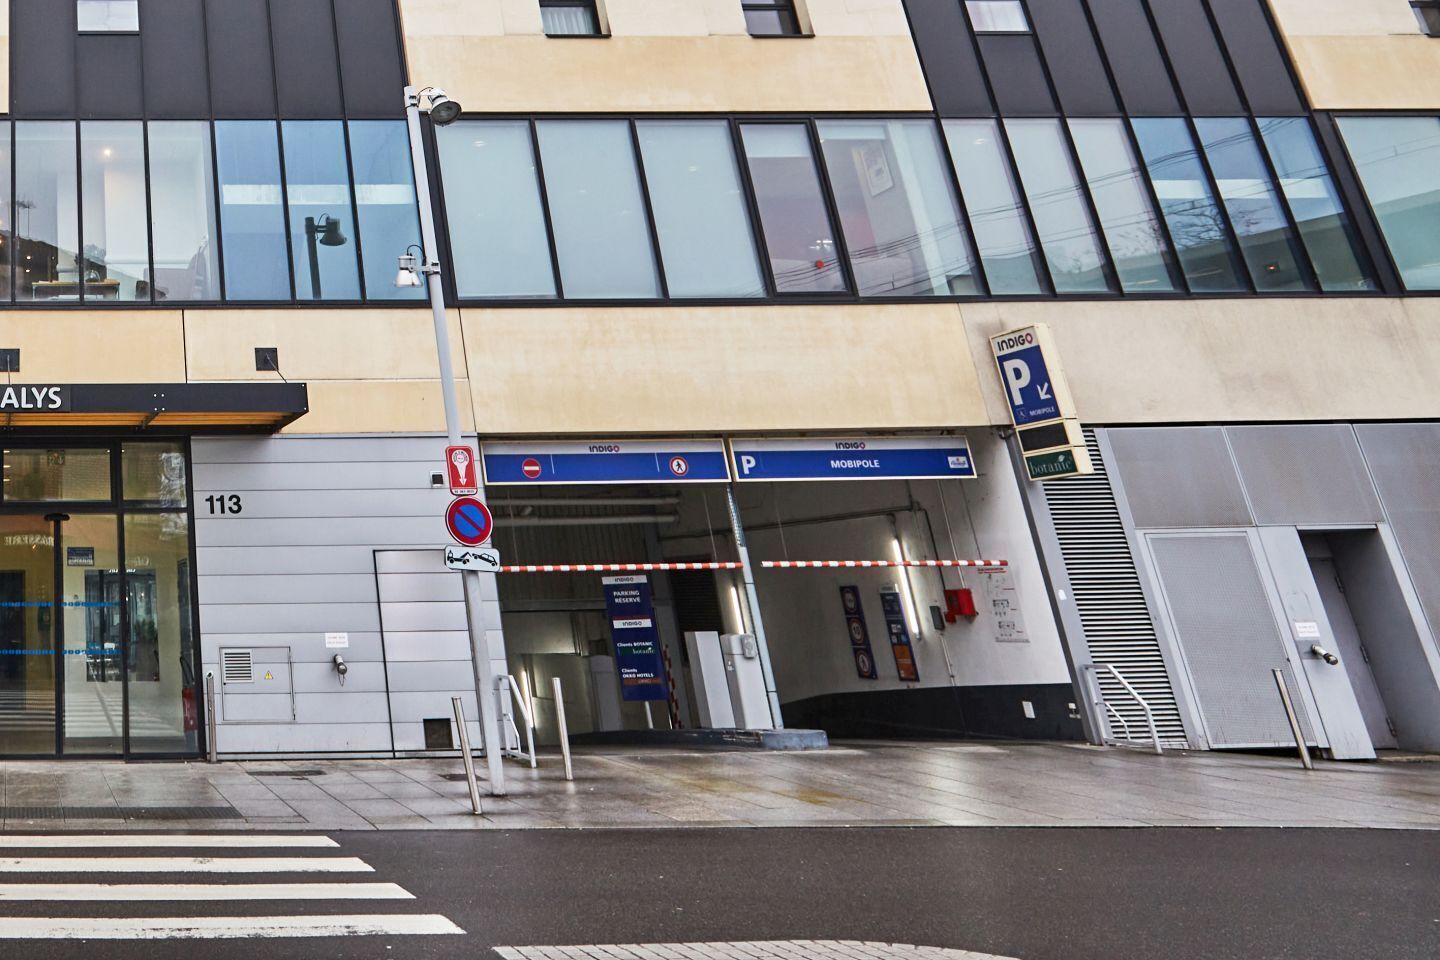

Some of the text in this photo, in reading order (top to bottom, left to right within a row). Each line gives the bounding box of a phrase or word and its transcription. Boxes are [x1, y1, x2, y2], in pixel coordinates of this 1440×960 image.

[997, 332, 1034, 352] INDIGO
[1003, 358, 1031, 406] P
[1029, 406, 1056, 417] MOBIPOLE
[588, 445, 620, 453] INDIGO
[835, 442, 866, 450] INDIGO
[741, 455, 881, 474] P MOBIPOLE
[1029, 457, 1073, 476] botanic
[205, 494, 242, 515] 113
